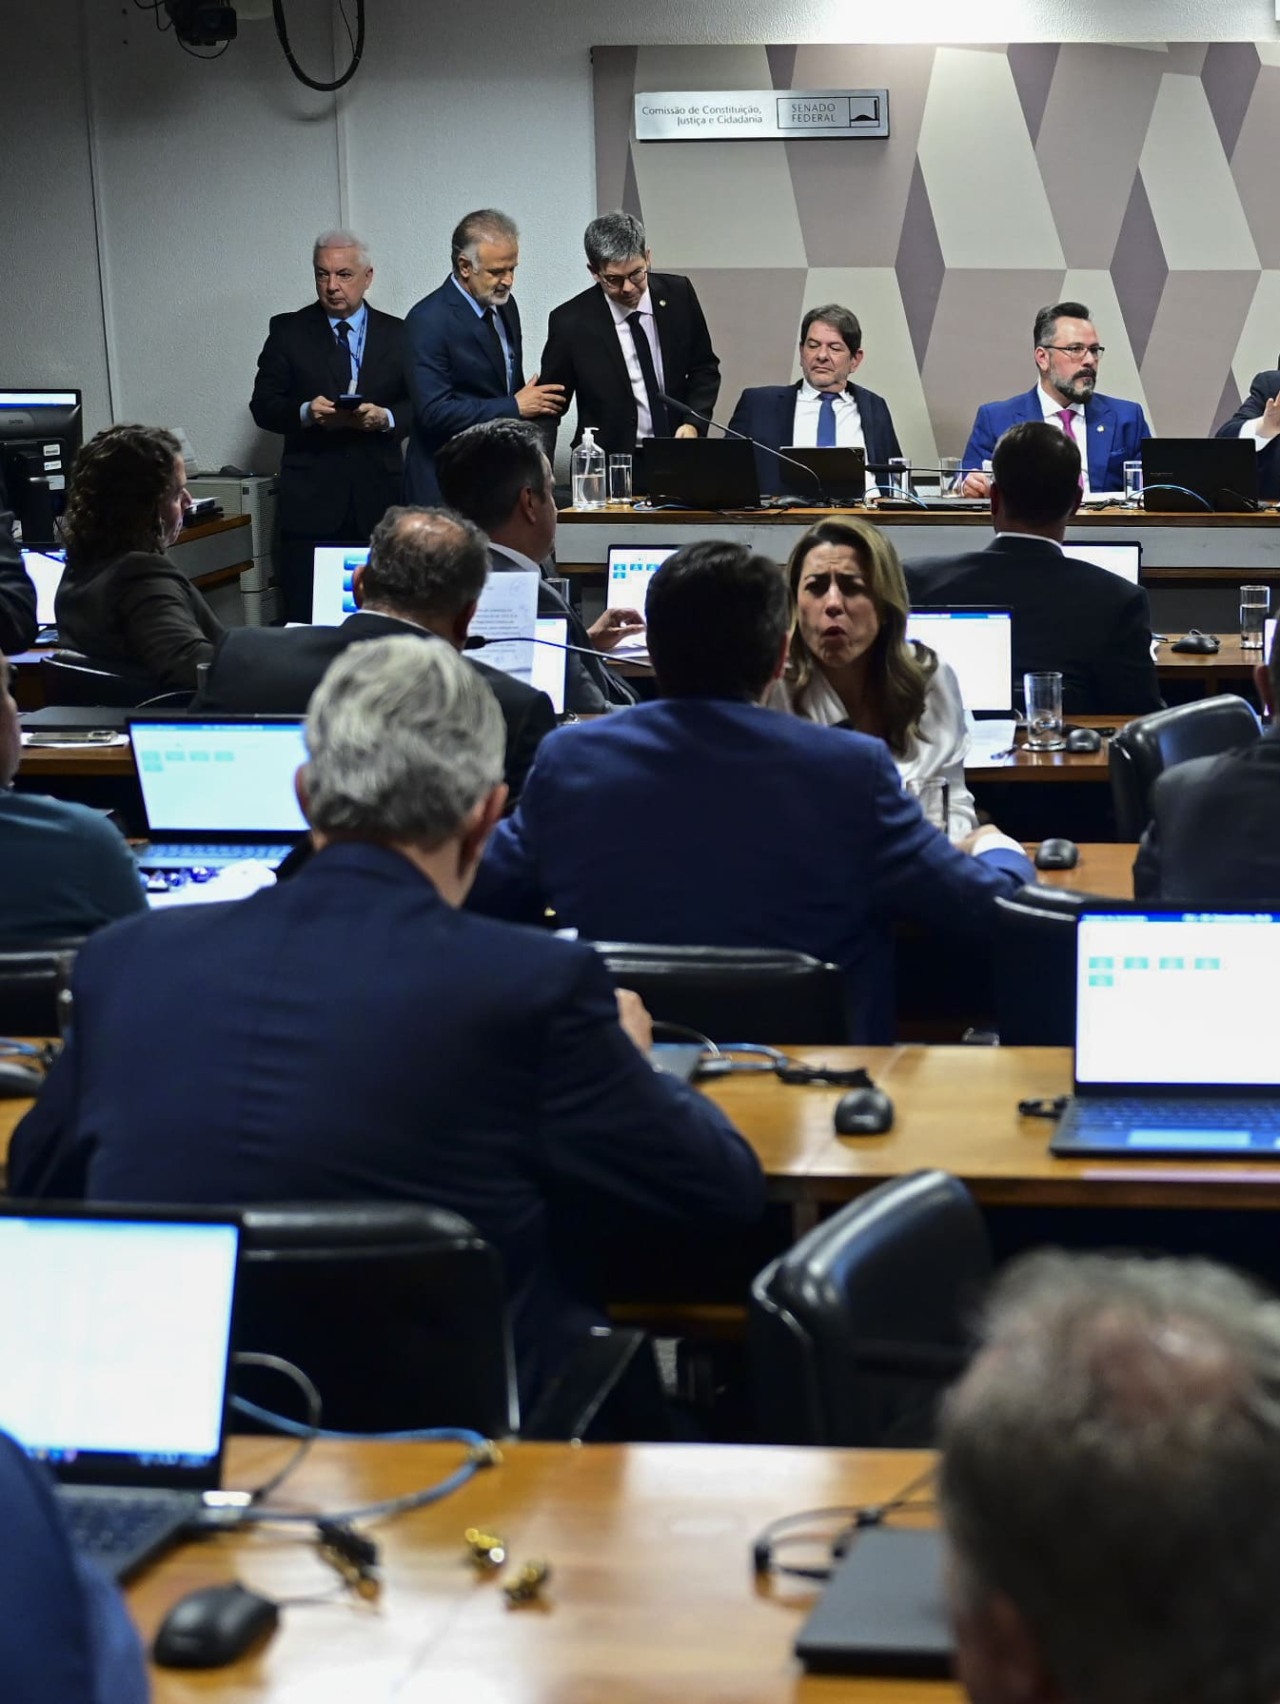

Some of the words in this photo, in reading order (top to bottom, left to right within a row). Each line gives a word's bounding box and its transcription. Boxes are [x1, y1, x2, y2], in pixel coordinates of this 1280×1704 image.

[641, 105, 686, 115] Comissão
[688, 106, 700, 115] de
[702, 105, 762, 116] Constituição,
[791, 103, 836, 113] SENADO
[677, 116, 707, 126] Justiça
[716, 115, 763, 124] Cidadania
[791, 113, 836, 123] FEDERAL
